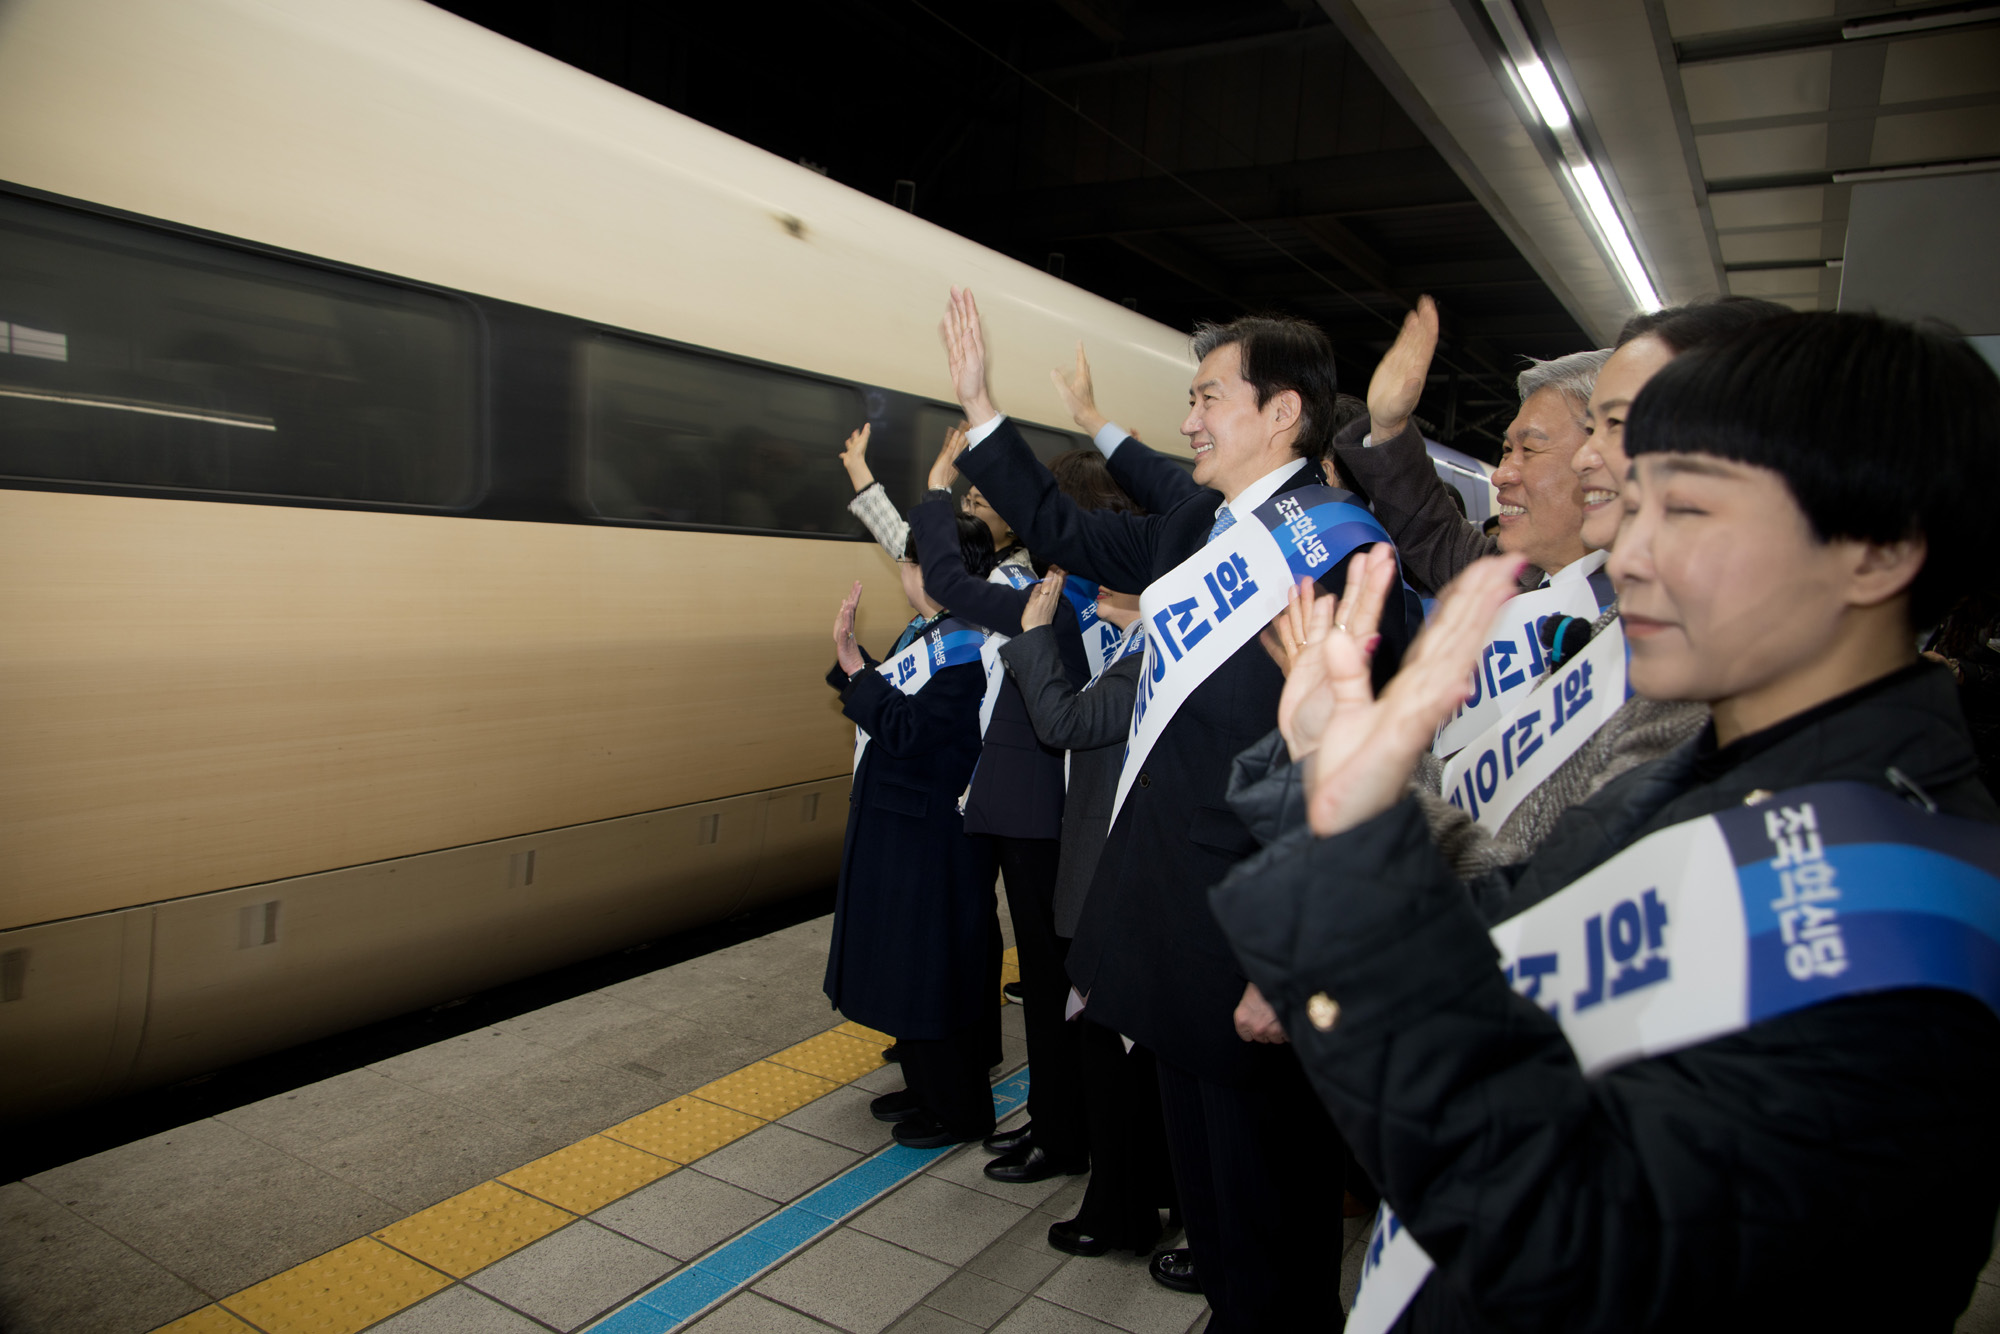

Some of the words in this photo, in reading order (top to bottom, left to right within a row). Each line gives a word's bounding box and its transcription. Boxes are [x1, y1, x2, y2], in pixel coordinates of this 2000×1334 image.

[1275, 496, 1330, 568] 조국혁신당
[931, 628, 946, 666] 조국혁신당
[1449, 659, 1593, 822] 혁신으
[1765, 803, 1848, 980] 조국혁신당
